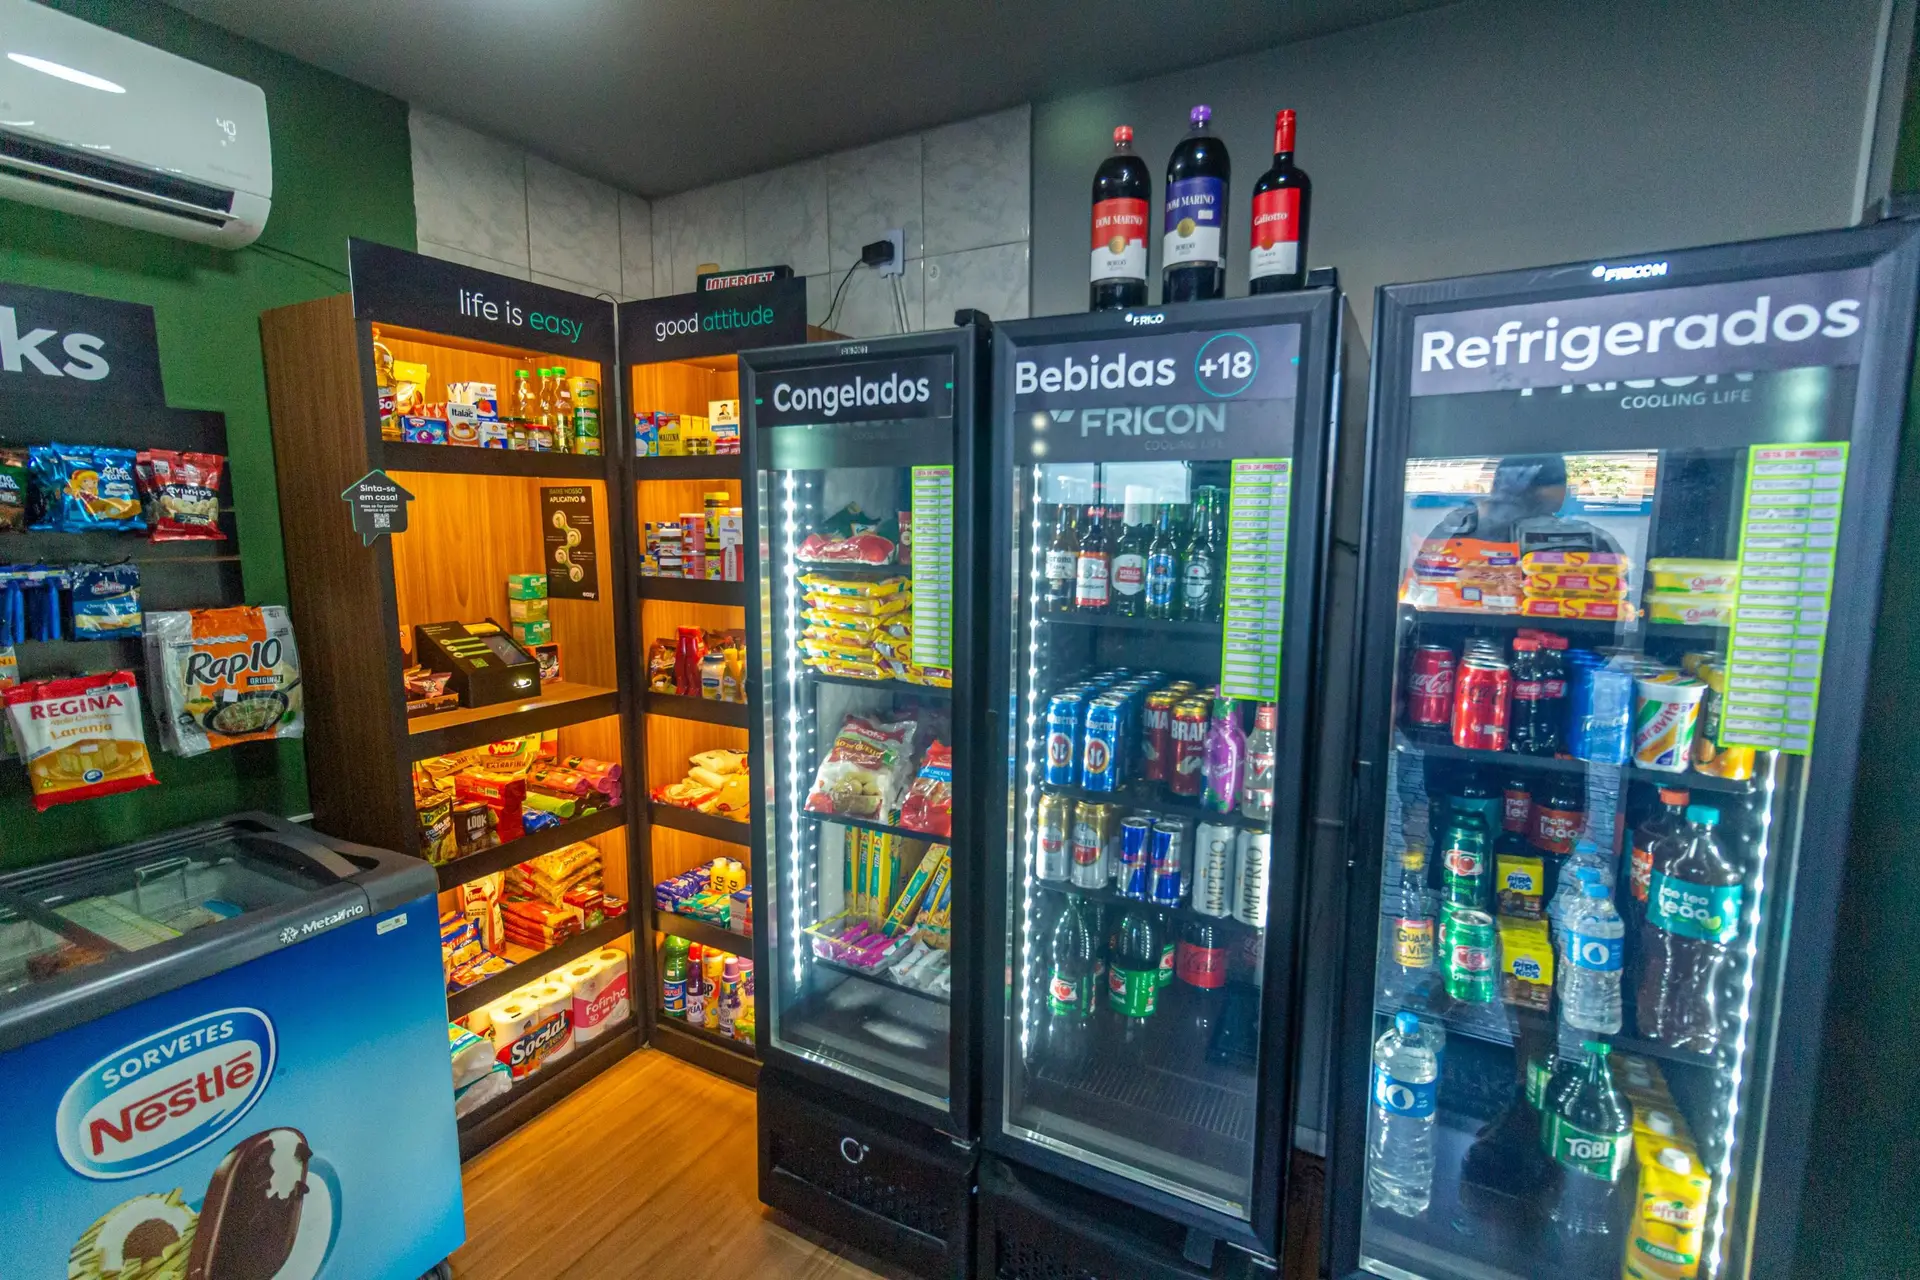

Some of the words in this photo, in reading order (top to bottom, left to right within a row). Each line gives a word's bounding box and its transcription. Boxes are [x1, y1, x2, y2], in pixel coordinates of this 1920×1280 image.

[1181, 194, 1215, 206] MARINO
[1112, 214, 1143, 225] MARINO
[705, 271, 775, 291] INTERNET
[460, 288, 499, 321] life
[505, 300, 523, 326] is
[529, 311, 583, 343] easy
[655, 312, 699, 342] good
[703, 304, 774, 332] attitude
[1419, 295, 1861, 372] Refrigerados
[1015, 353, 1176, 395] Bebidas
[1199, 351, 1253, 380] +18
[773, 372, 931, 417] Congelados
[1620, 391, 1706, 410] COOLING
[1712, 388, 1753, 404] LIFE
[1080, 403, 1227, 438] FRICON
[360, 484, 396, 492] Sinta-se
[582, 591, 595, 599] easy
[30, 694, 123, 720] REGINA
[50, 722, 112, 740] Laranja
[467, 813, 487, 832] LOOK
[1540, 815, 1573, 826] matte
[1540, 821, 1578, 839] leão
[585, 987, 627, 1016] Fofinho
[511, 1010, 567, 1065] Social
[102, 1020, 234, 1089] SORVETES
[1565, 1137, 1610, 1159] TOBI
